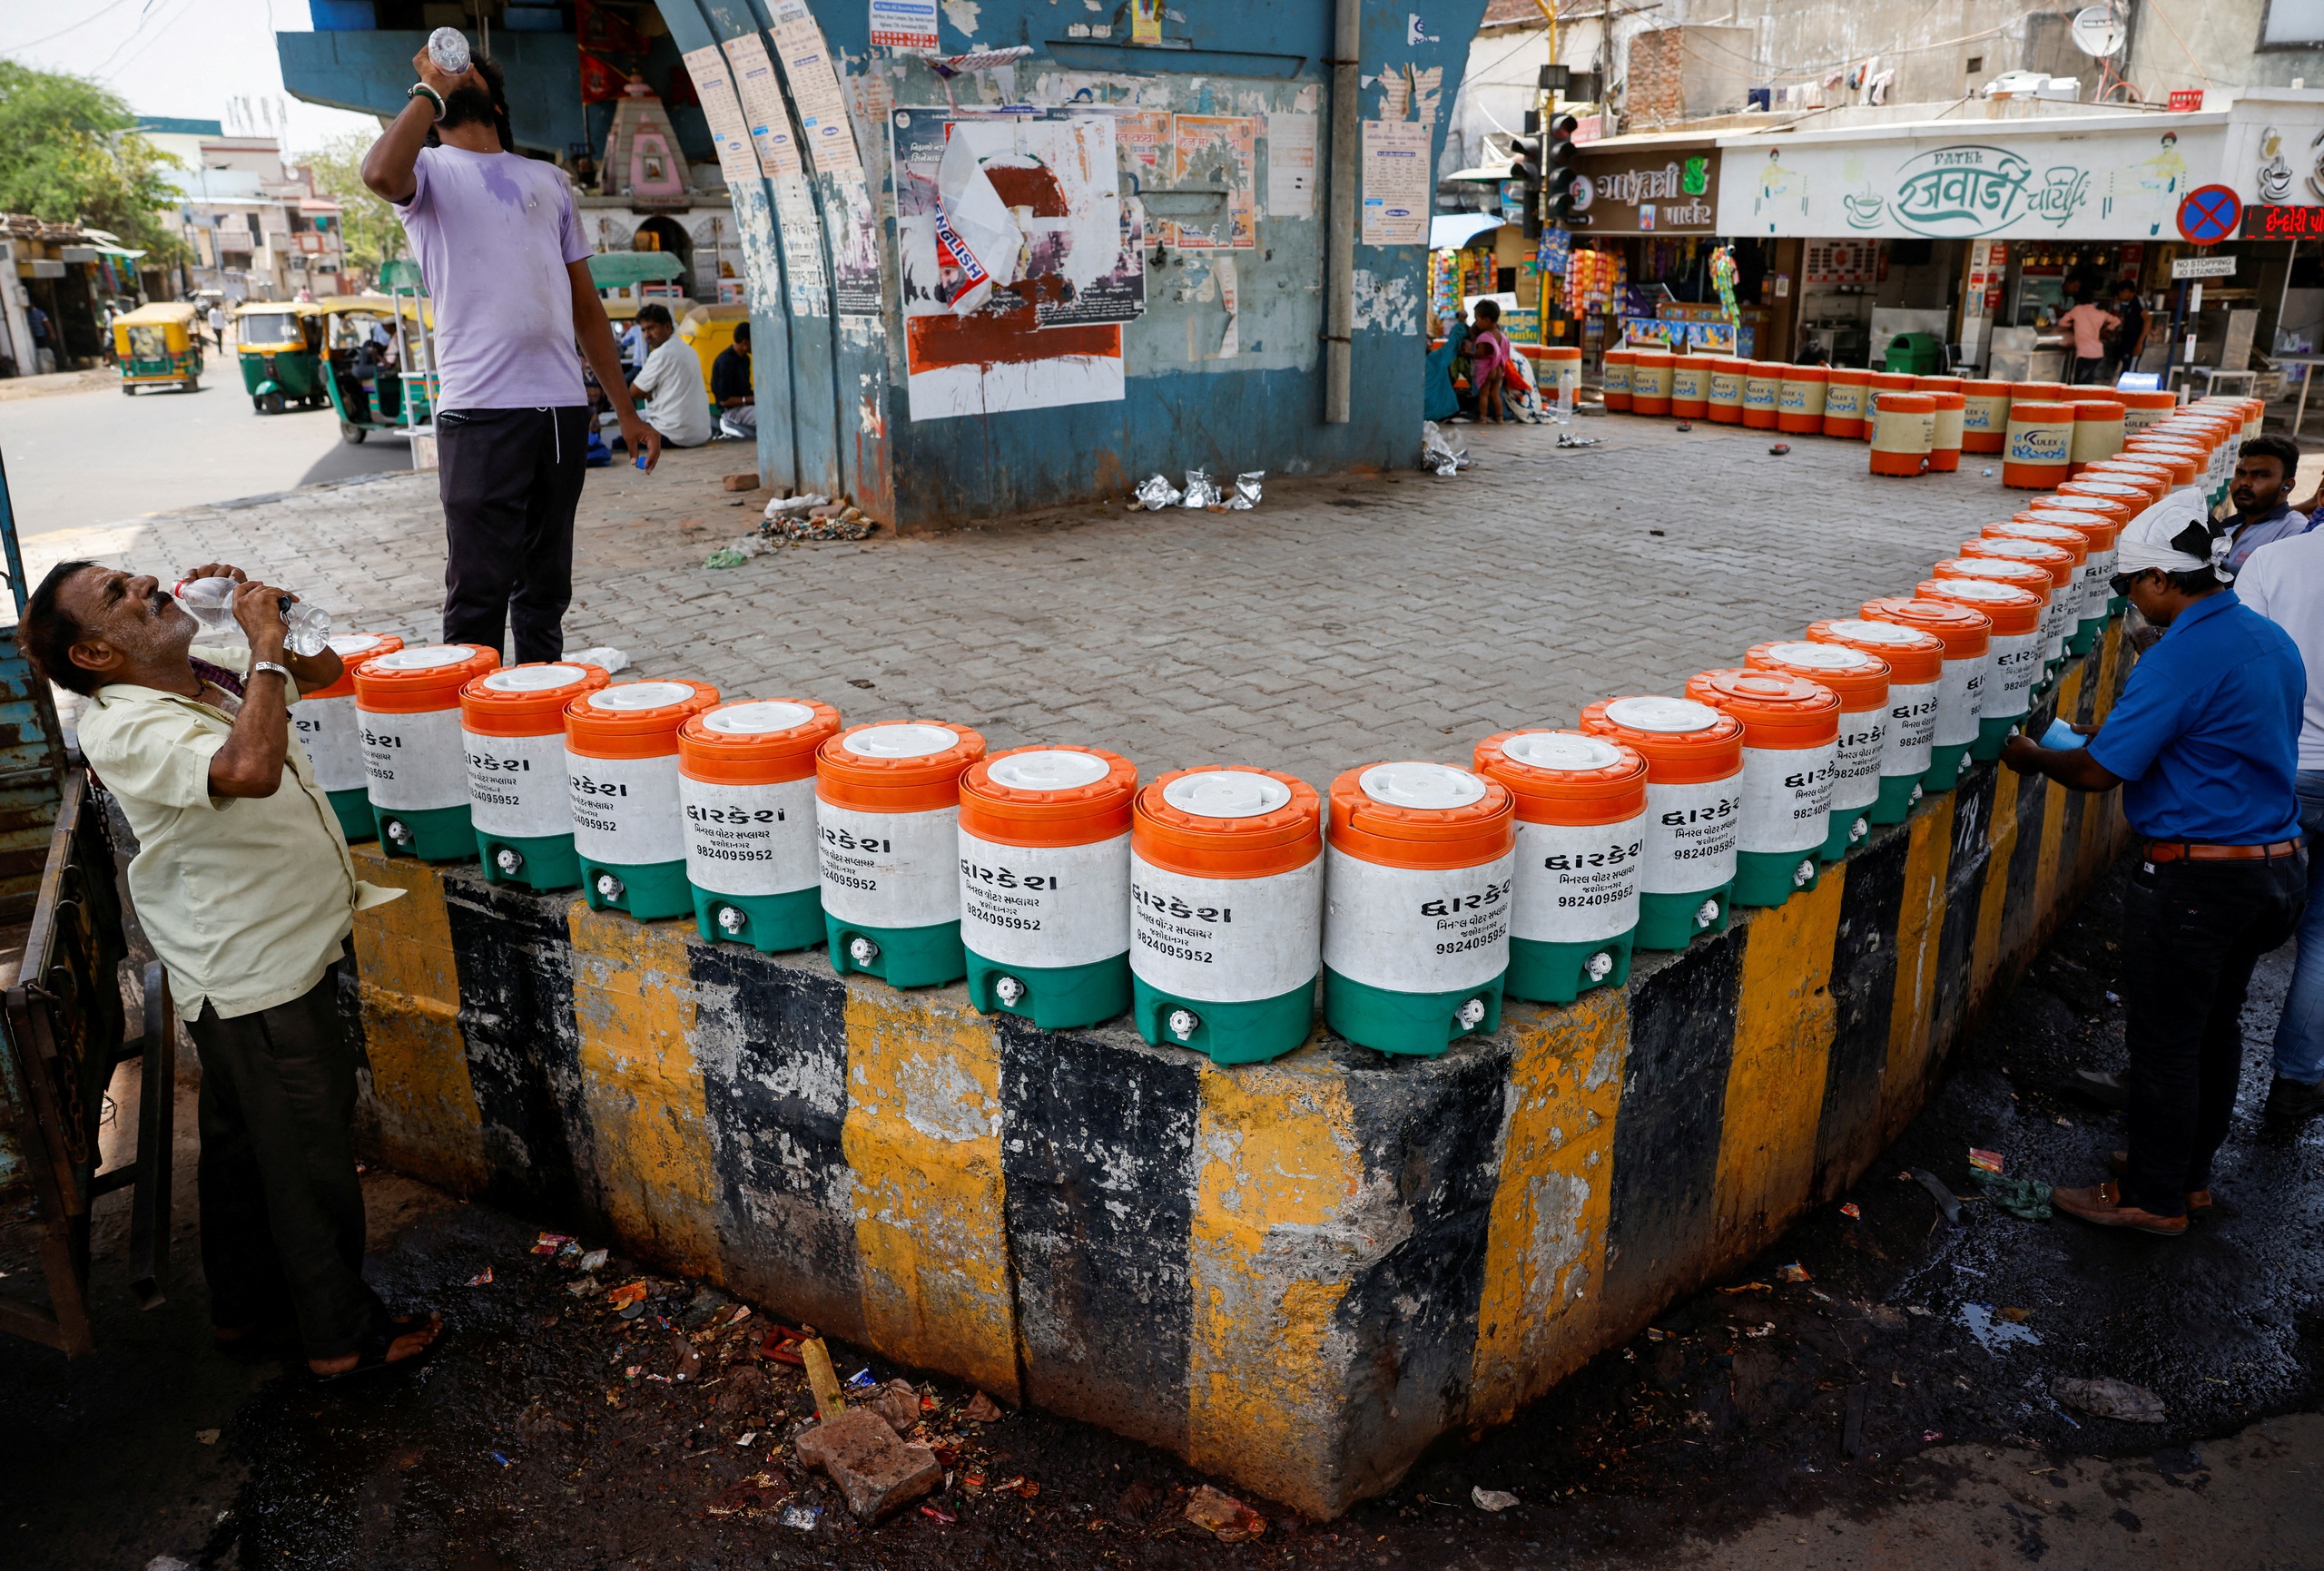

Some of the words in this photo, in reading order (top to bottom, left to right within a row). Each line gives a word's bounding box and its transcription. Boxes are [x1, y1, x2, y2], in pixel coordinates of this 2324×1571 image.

[1935, 151, 1983, 165] PATEL
[935, 202, 982, 280] ENGLISH
[2176, 260, 2189, 268] NO
[2191, 258, 2231, 268] STOPPING
[2190, 267, 2230, 276] STANDING
[2024, 429, 2058, 446] KULEX
[686, 804, 786, 824] દ્વારકેશ
[694, 823, 714, 837] મિનરલ
[716, 829, 734, 840] વોટર
[736, 830, 771, 840] સપ્લાયર
[1675, 827, 1702, 840] મિનરલ
[696, 844, 773, 861] 9824095952
[710, 839, 750, 849] જશોદાનગર
[844, 856, 875, 869] સપ્લાયર
[1544, 839, 1643, 871] દ્વારકેશ
[960, 859, 1058, 891] દ્વારકેશ
[1560, 873, 1590, 885] મિનરલ
[1591, 870, 1611, 884] વોટર
[1611, 865, 1635, 880] સપ્લાયર
[1558, 884, 1634, 908] 9824095952
[1581, 881, 1622, 895] જશોદાનગર
[1003, 894, 1039, 908] સપ્લાયર
[1132, 882, 1232, 923] દ્વારકેશ
[967, 901, 1041, 931] 9824095952
[1470, 914, 1487, 928] વોટર
[1176, 924, 1213, 940] સપ્લાયર
[1436, 922, 1507, 955] 9824095952
[1137, 928, 1214, 964] 9824095952
